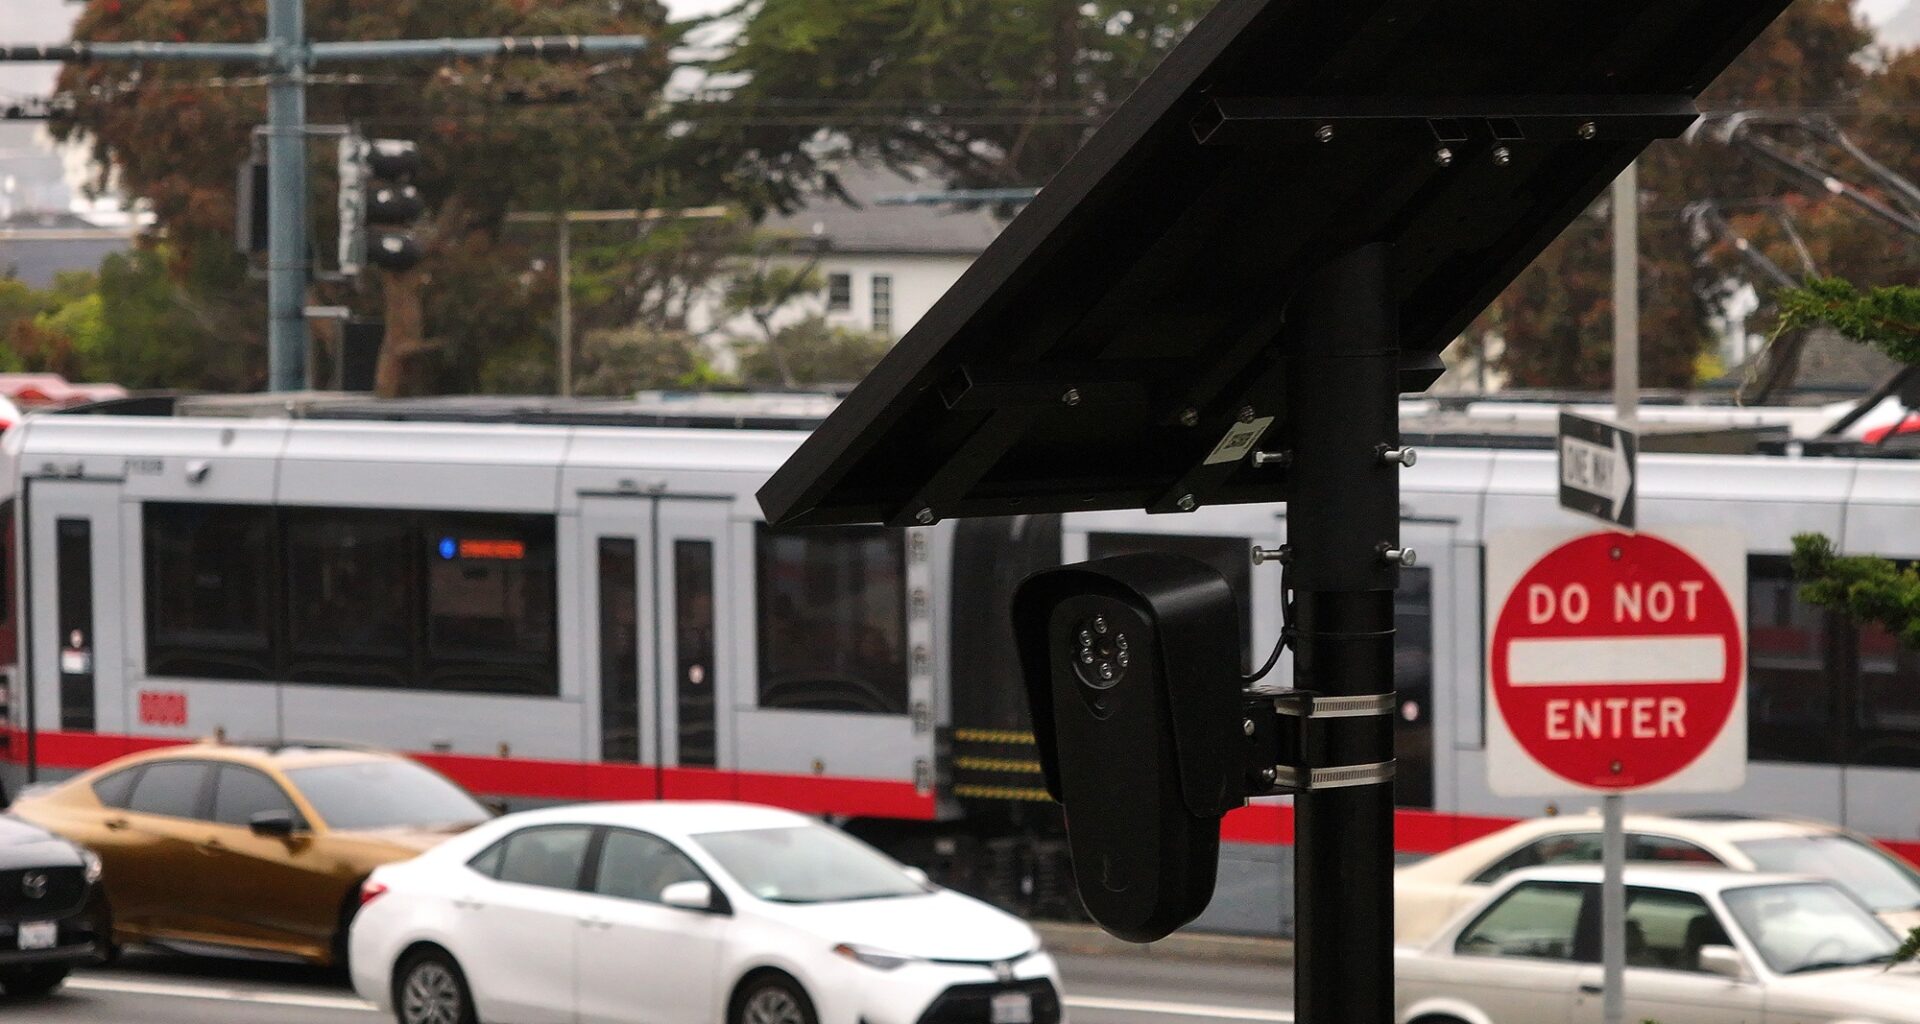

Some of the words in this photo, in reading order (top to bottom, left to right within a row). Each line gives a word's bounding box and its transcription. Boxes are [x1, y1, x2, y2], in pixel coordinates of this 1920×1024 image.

[1528, 582, 1590, 625] DO
[1613, 580, 1704, 623] NOT
[1545, 697, 1687, 740] ENTER
